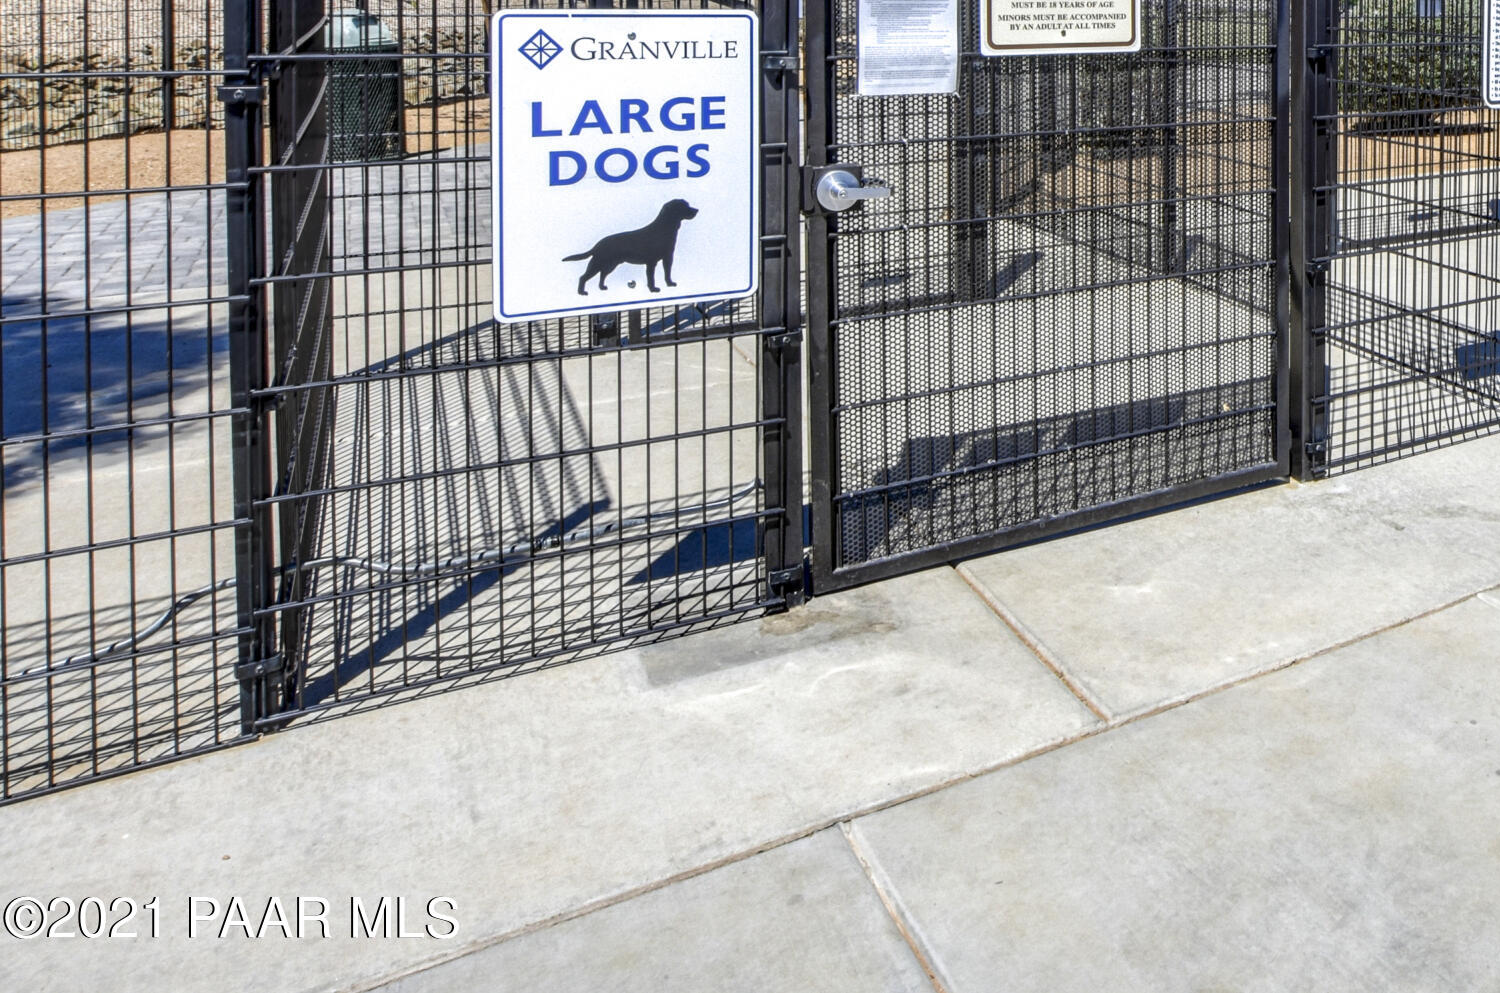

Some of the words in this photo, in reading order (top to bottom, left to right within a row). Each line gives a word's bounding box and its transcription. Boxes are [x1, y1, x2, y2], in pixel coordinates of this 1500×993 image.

[1074, 22, 1091, 30] ALL
[570, 36, 738, 61] GRANVILLE
[531, 96, 726, 138] LARGE
[549, 143, 710, 187] DOGS
